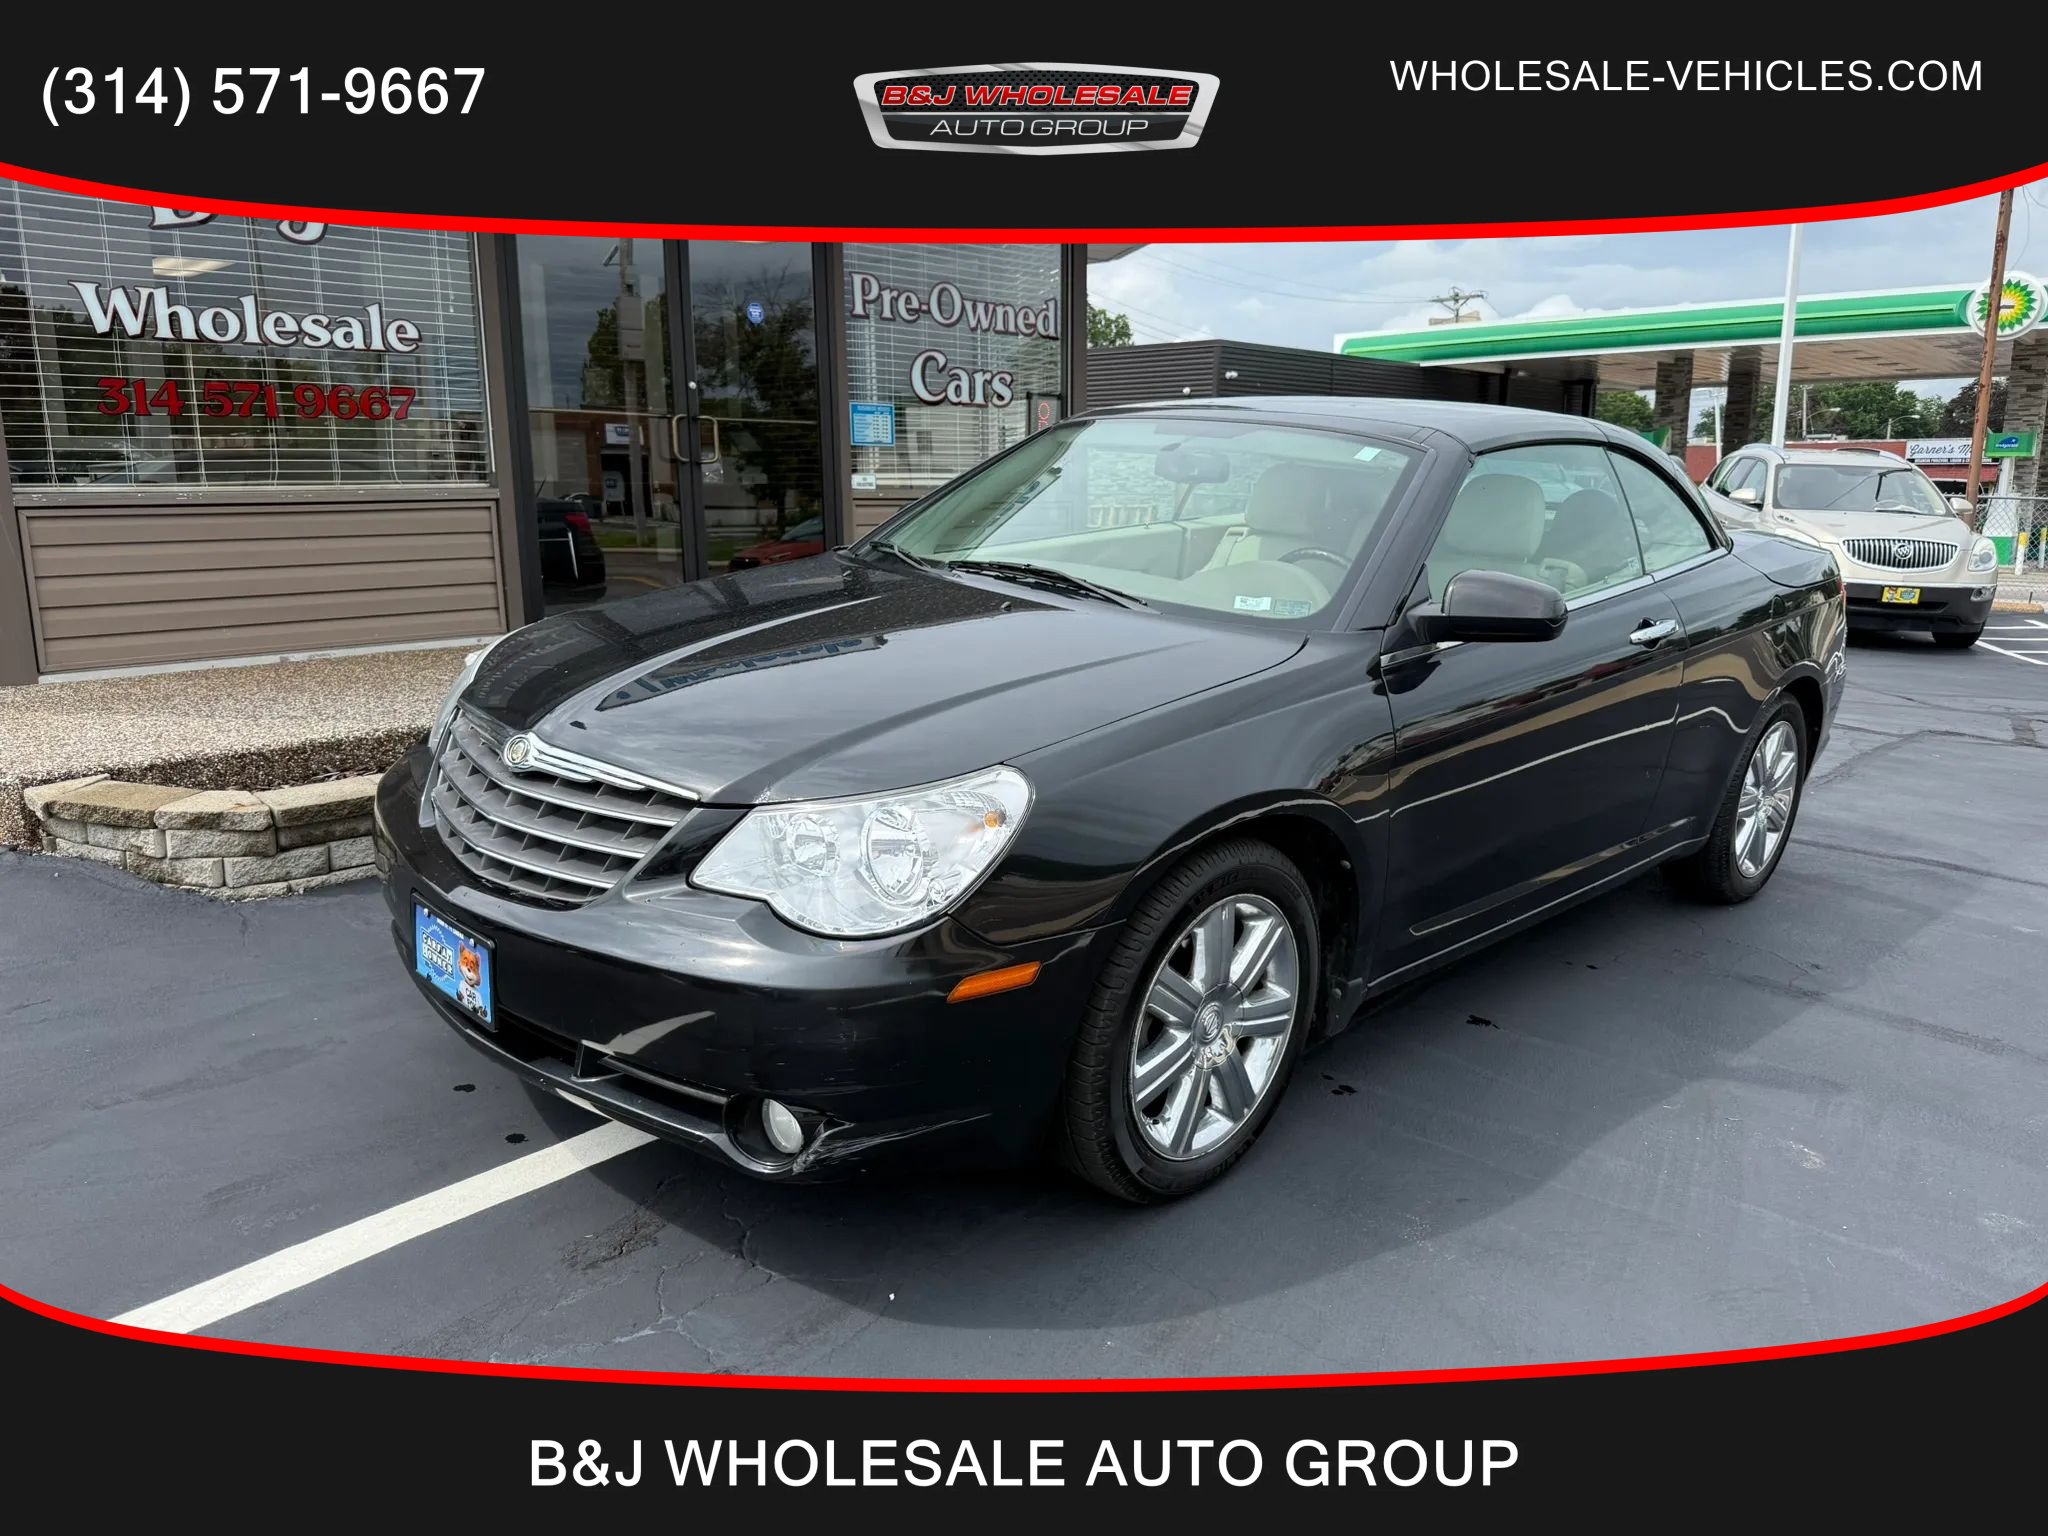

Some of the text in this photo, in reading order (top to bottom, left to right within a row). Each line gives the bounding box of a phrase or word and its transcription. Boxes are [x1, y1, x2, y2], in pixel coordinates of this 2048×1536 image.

[68, 280, 422, 353] Wholesale
[851, 272, 1059, 340] Pre-Owned
[97, 376, 417, 420] 314 571 9667
[910, 350, 1014, 407] Cars
